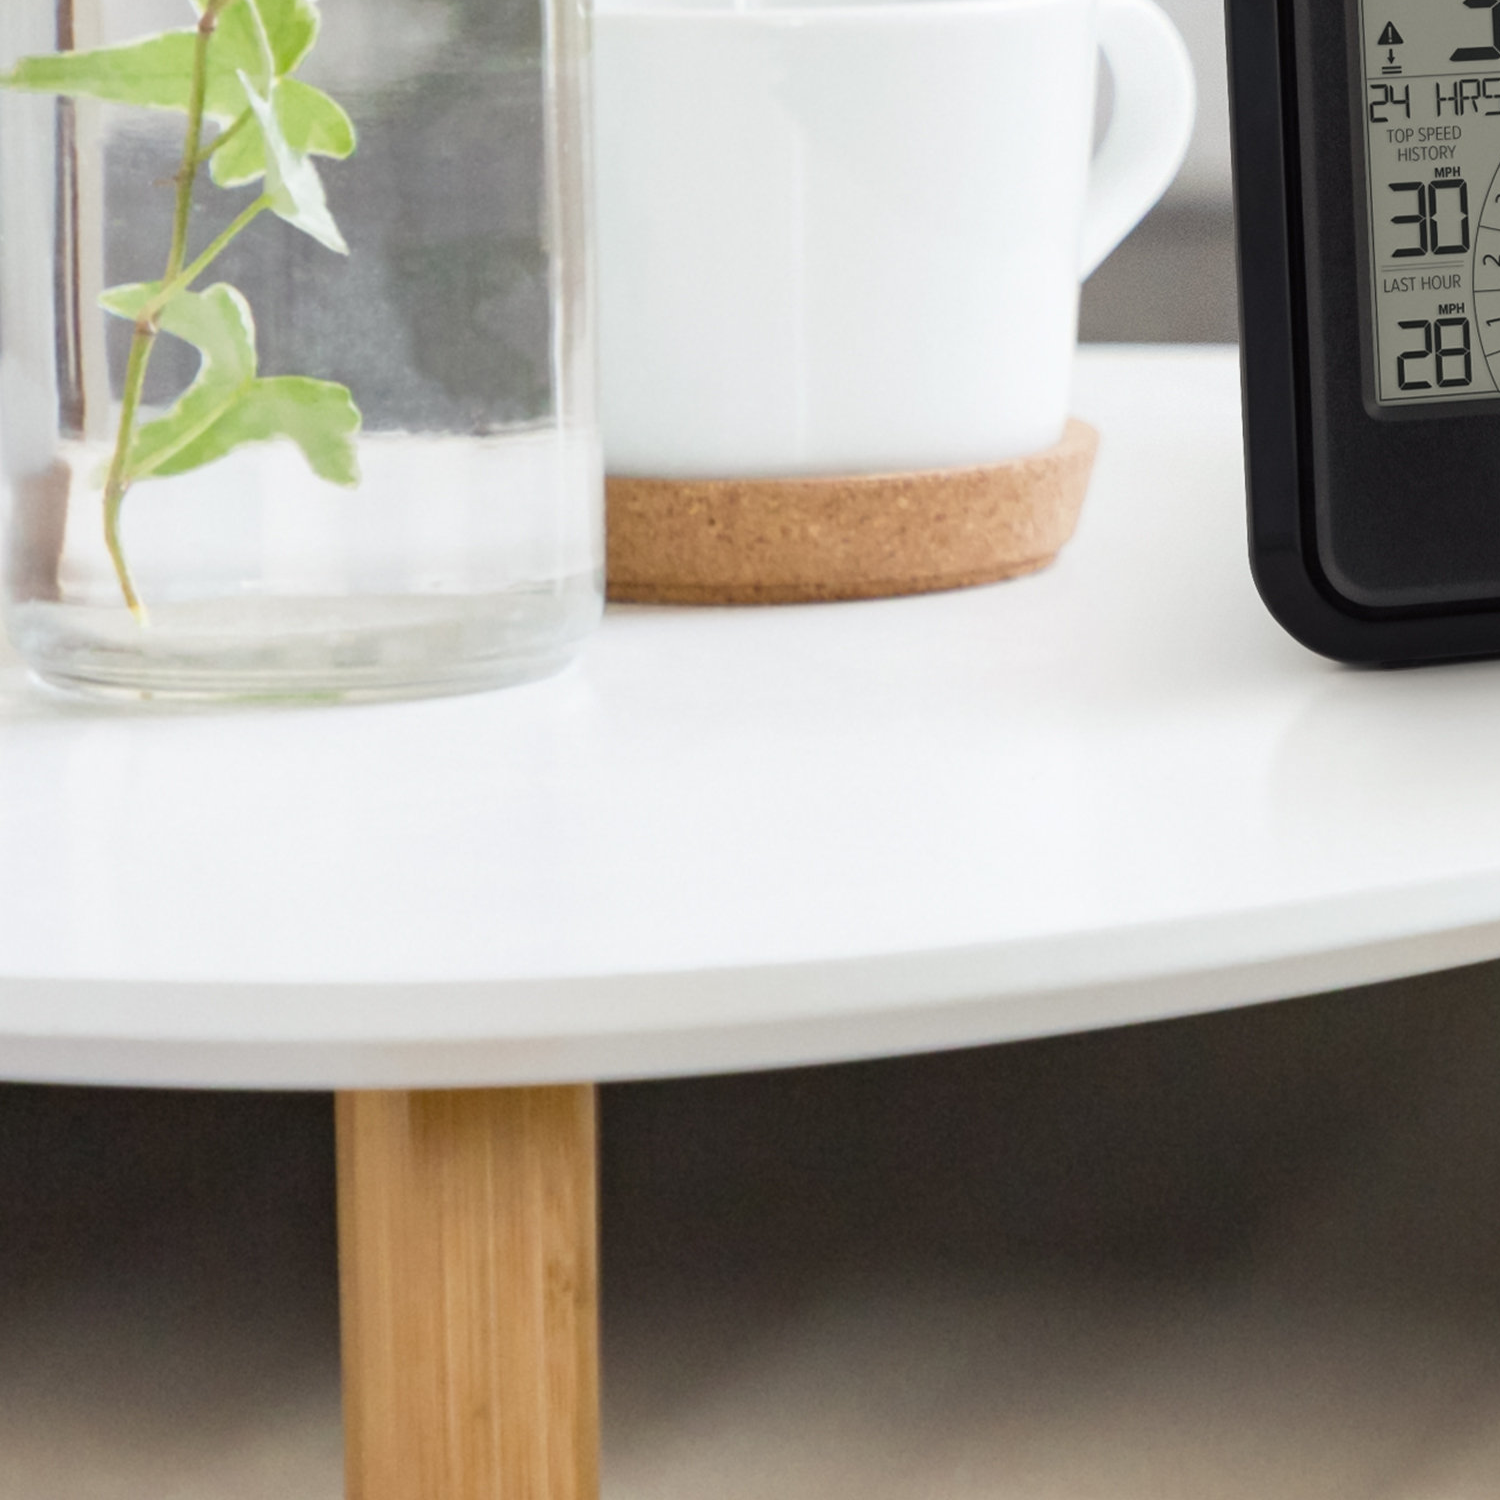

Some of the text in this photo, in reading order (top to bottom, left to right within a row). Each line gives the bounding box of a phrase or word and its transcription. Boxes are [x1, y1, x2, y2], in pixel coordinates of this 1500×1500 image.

[1369, 82, 1411, 123] 24
[1386, 125, 1462, 143] TOP SPEED
[1397, 145, 1456, 161] HISTORY
[1434, 166, 1461, 178] MPH
[1388, 178, 1470, 258] 30
[1383, 274, 1461, 292] LAST HOUR
[1438, 303, 1465, 315] MPH
[1397, 317, 1472, 390] 28
